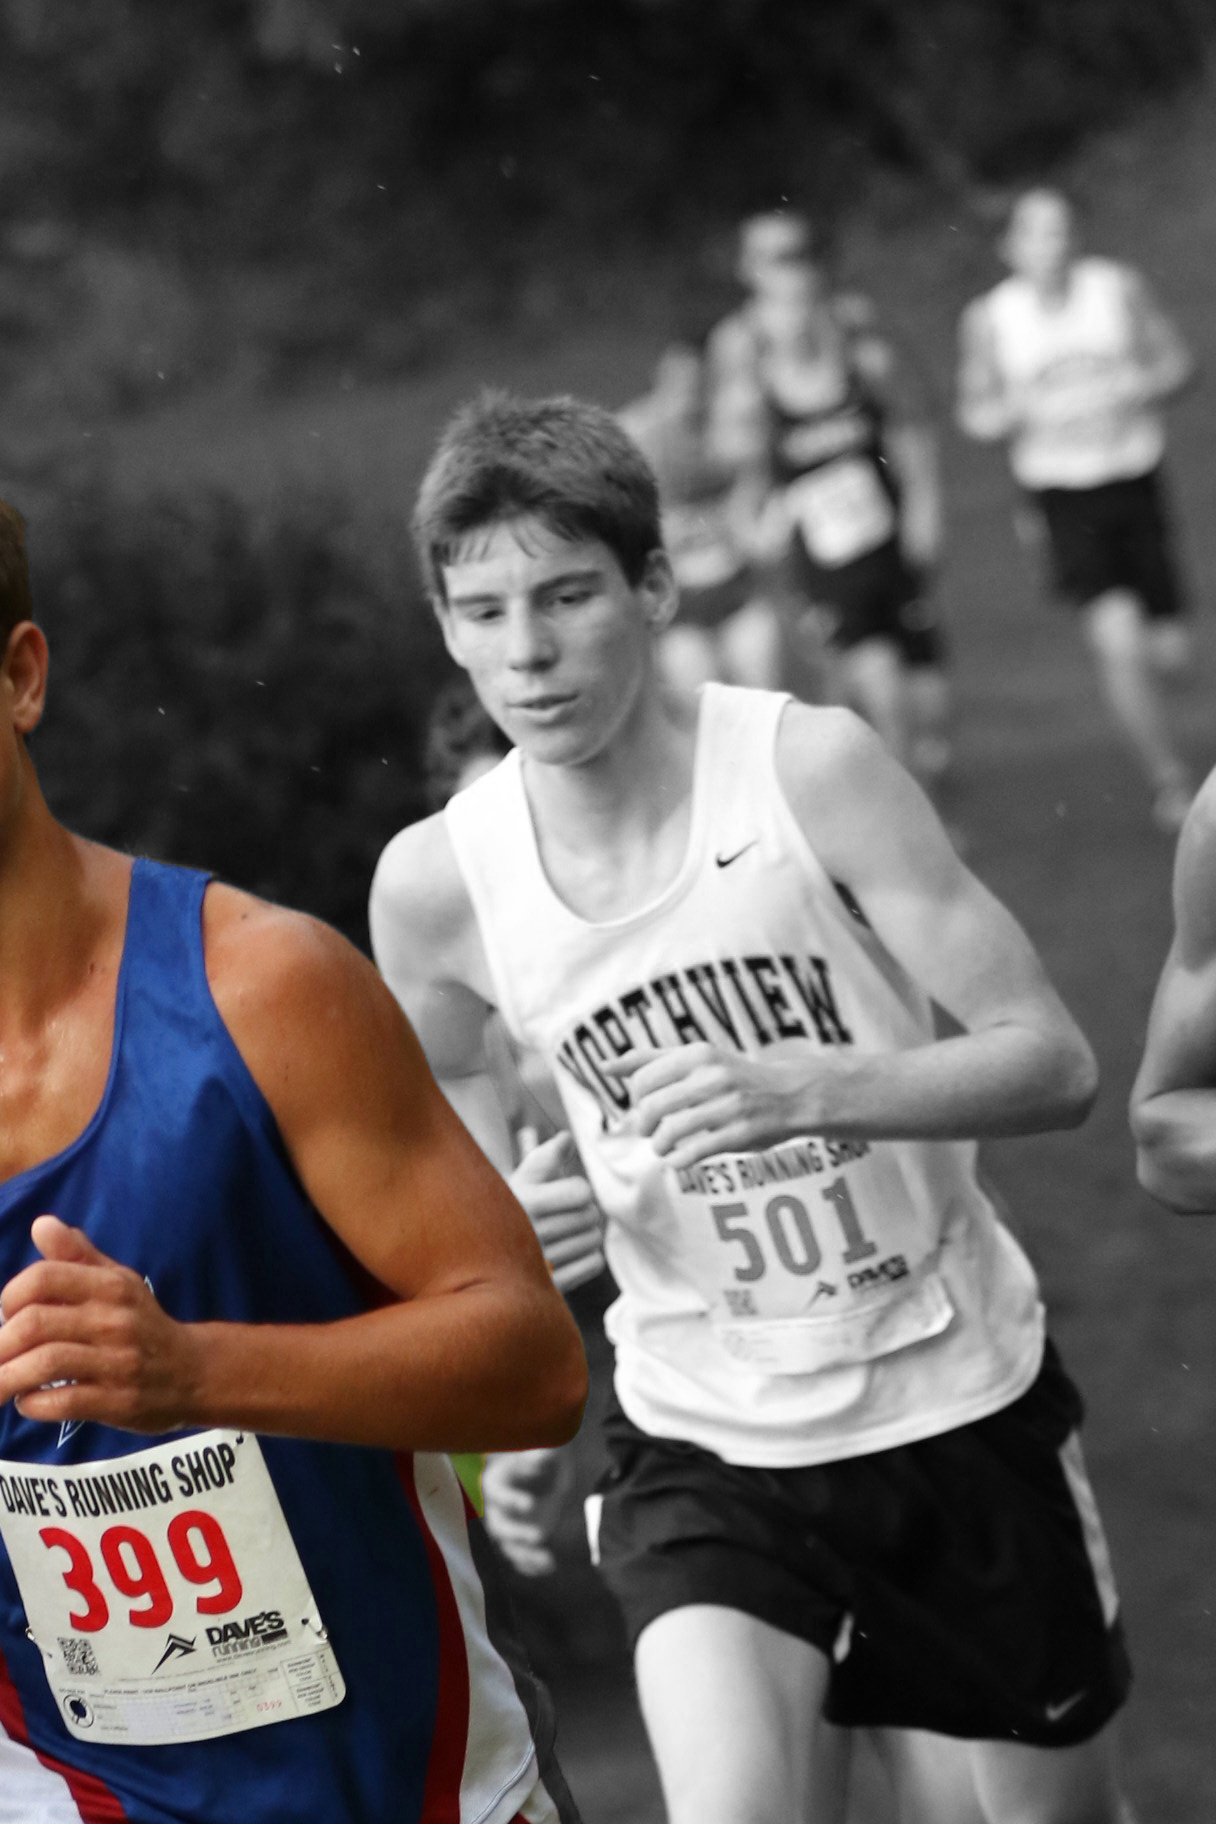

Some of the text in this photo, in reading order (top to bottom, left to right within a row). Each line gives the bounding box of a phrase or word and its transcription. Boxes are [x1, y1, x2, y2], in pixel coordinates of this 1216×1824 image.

[710, 1176, 878, 1282] 501
[65, 1463, 170, 1518] RUNNING
[171, 1443, 236, 1497] SHOP
[39, 1510, 243, 1633] 399
[206, 1611, 284, 1645] DAVE'S
